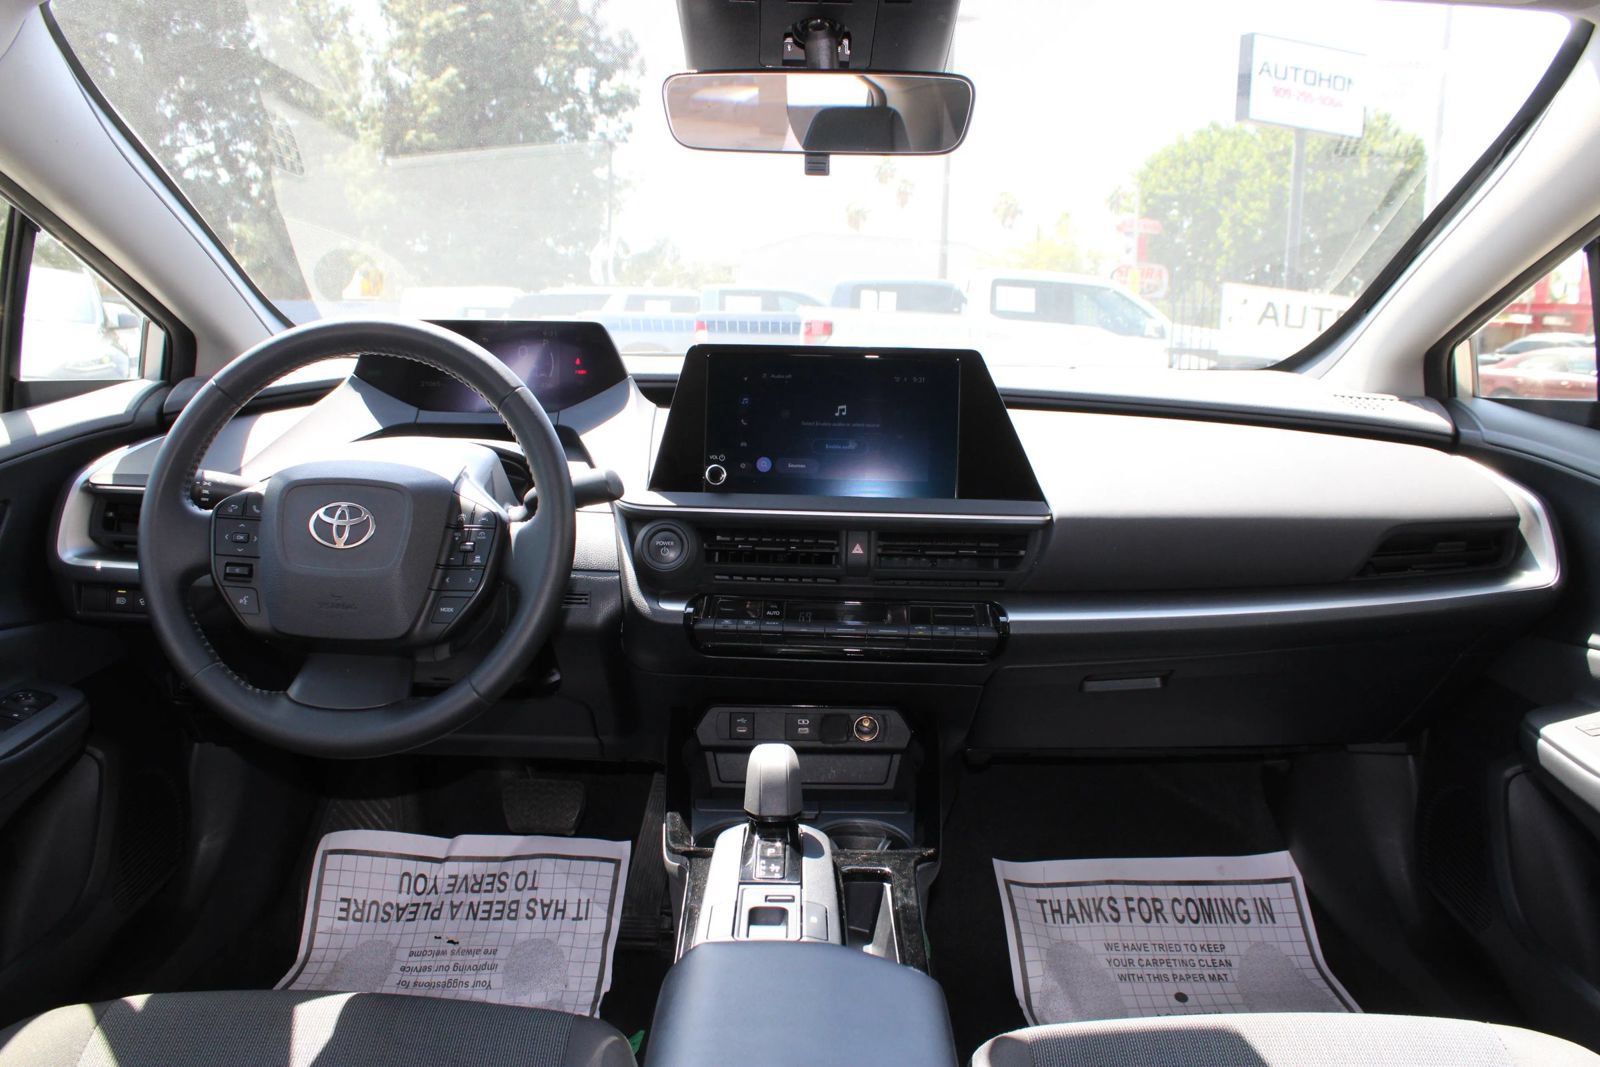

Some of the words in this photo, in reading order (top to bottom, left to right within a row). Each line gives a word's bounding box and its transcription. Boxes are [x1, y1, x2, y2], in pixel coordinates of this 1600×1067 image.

[767, 848, 776, 857] P
[398, 872, 439, 896] YOU
[445, 871, 509, 894] SERVE
[514, 869, 539, 892] TO
[337, 897, 444, 923] PLEASURE
[449, 900, 464, 921] A
[465, 899, 520, 921] BEEN
[525, 898, 567, 921] HAS
[571, 898, 591, 921] IT
[1036, 895, 1121, 924] THANKS
[1123, 896, 1169, 924] FOR
[1171, 897, 1252, 925] COMING
[1253, 897, 1277, 924] IN
[450, 948, 482, 958] always
[483, 948, 498, 956] are
[1103, 942, 1121, 952] WE
[1122, 942, 1149, 952] HAVE
[1152, 943, 1182, 953] TRIED
[1183, 943, 1198, 953] TO
[1199, 943, 1226, 953] KEEP
[409, 949, 448, 958] welcome
[434, 964, 450, 972] our
[453, 961, 498, 974] improving
[1105, 958, 1136, 968] YOUR
[1137, 958, 1197, 968] CARPETING
[1198, 958, 1233, 968] CLEAN
[400, 964, 433, 974] service
[413, 978, 470, 989] suggestions
[1117, 973, 1144, 983] WITH
[1146, 973, 1170, 982] THIS
[1171, 973, 1207, 983] PAPER
[1208, 973, 1229, 983] MAT
[396, 979, 411, 989] for
[471, 979, 492, 990] Your
